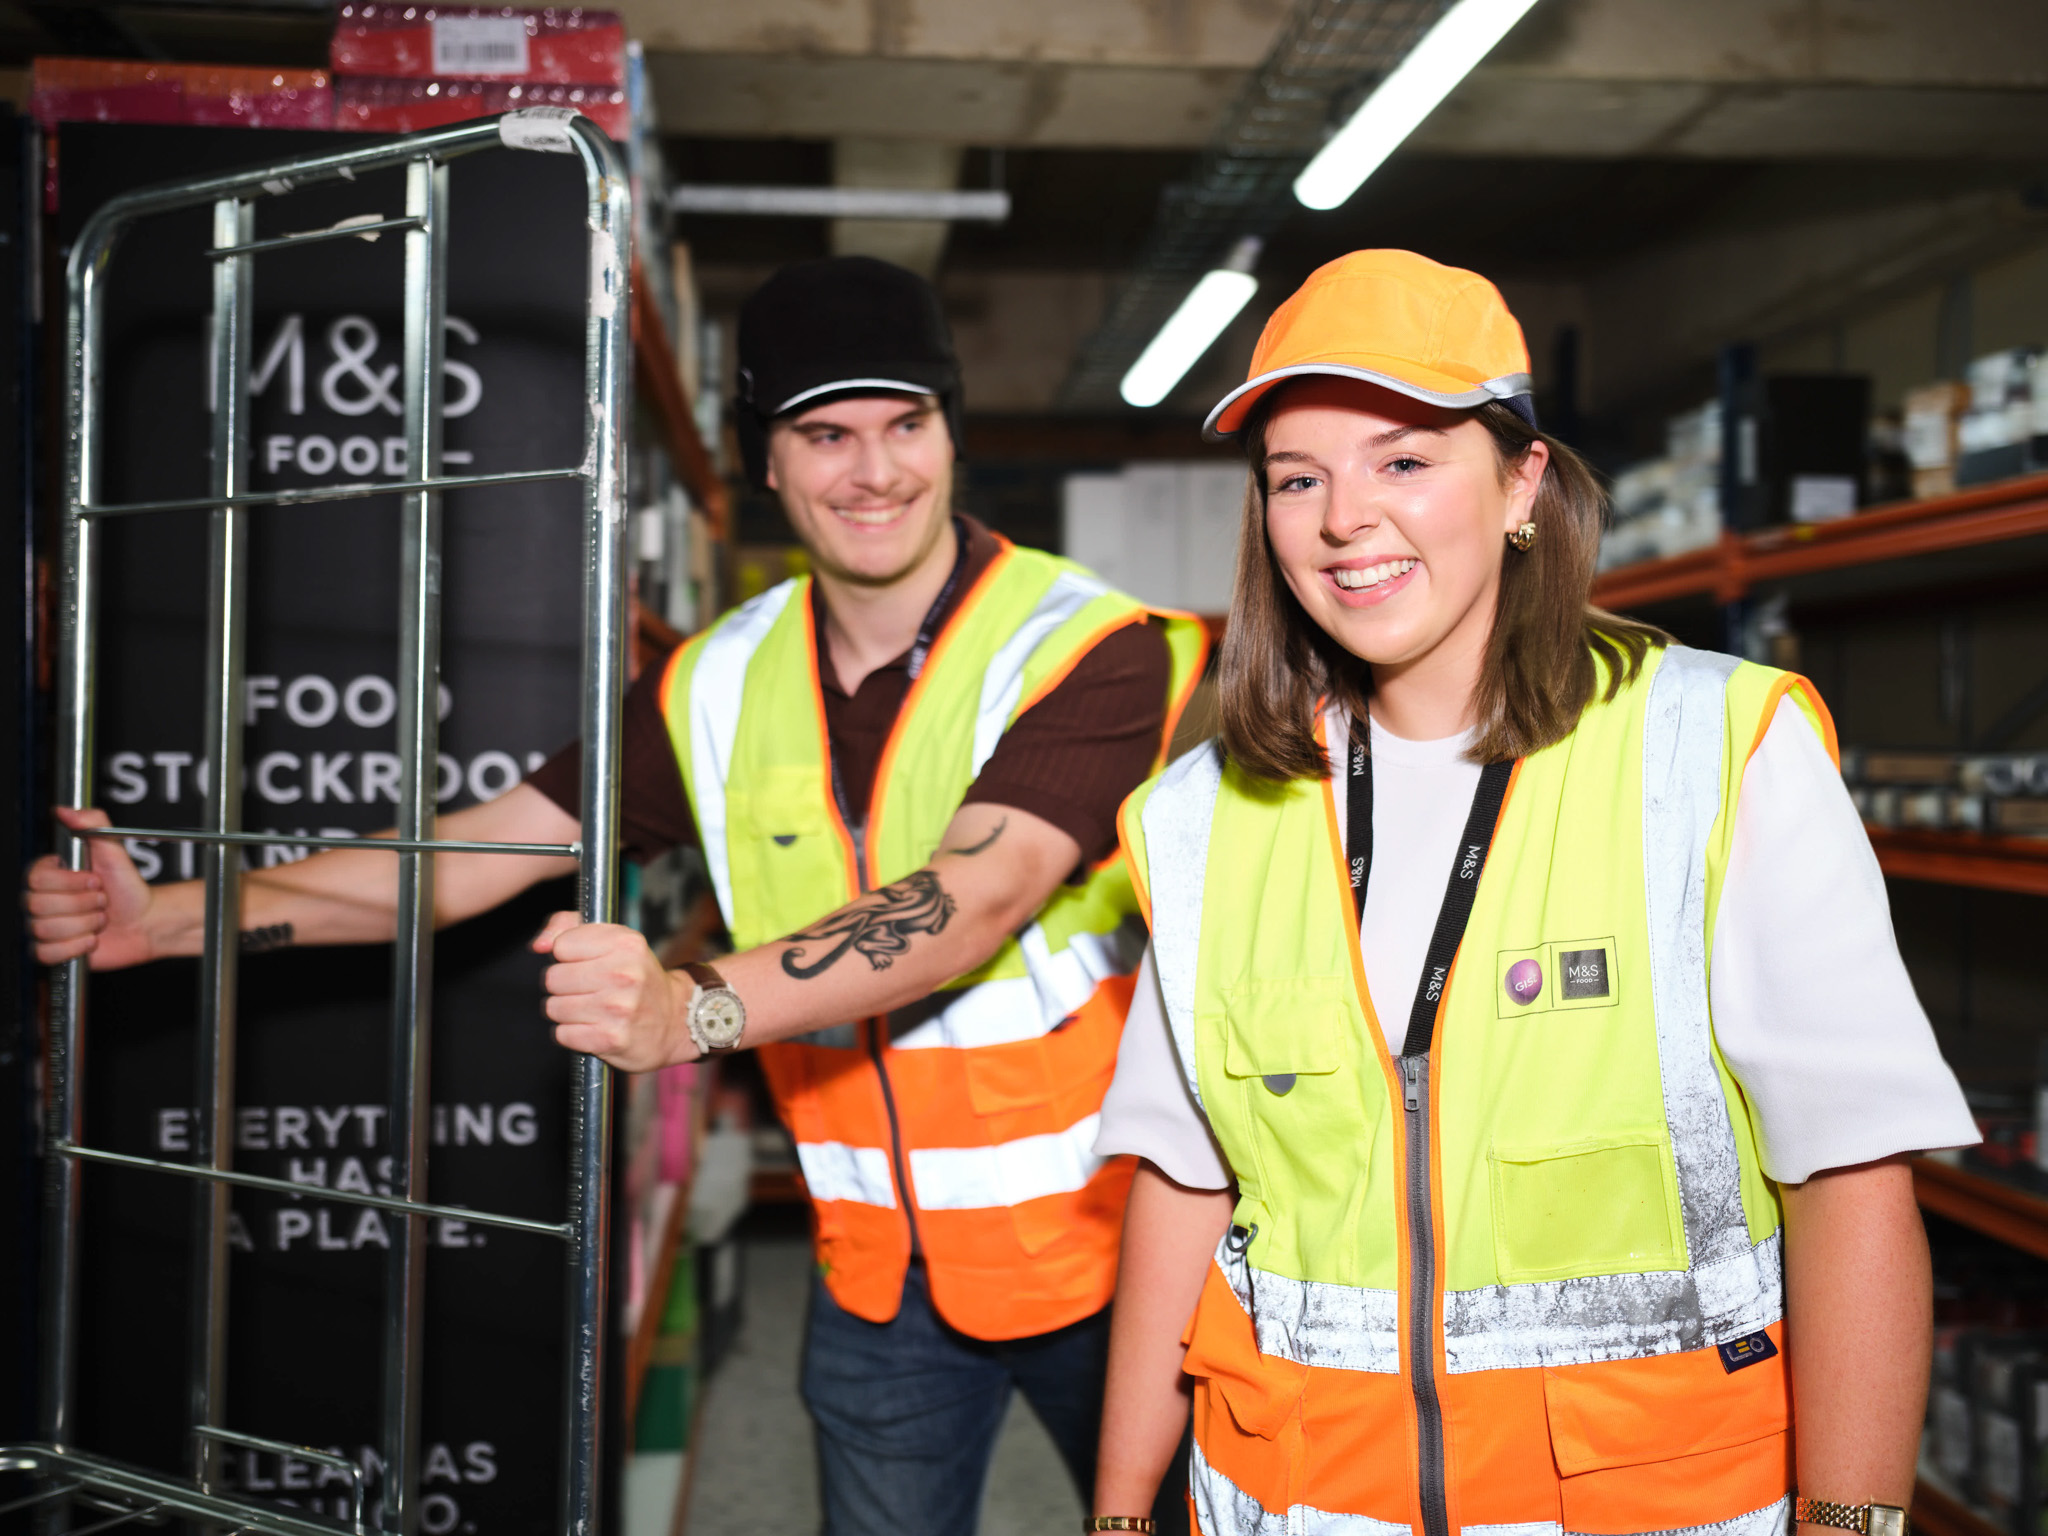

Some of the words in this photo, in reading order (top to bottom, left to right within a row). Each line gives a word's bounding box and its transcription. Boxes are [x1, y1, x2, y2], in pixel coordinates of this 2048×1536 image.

[208, 315, 483, 417] M&S
[1353, 745, 1365, 776] M&S
[1350, 857, 1364, 888] M&S
[1460, 845, 1481, 879] M&S
[1426, 967, 1446, 1002] M&S
[1568, 964, 1599, 978] M&S
[158, 1102, 538, 1151] EERYTING
[278, 1207, 487, 1250] PLAE.
[424, 1441, 497, 1484] AS
